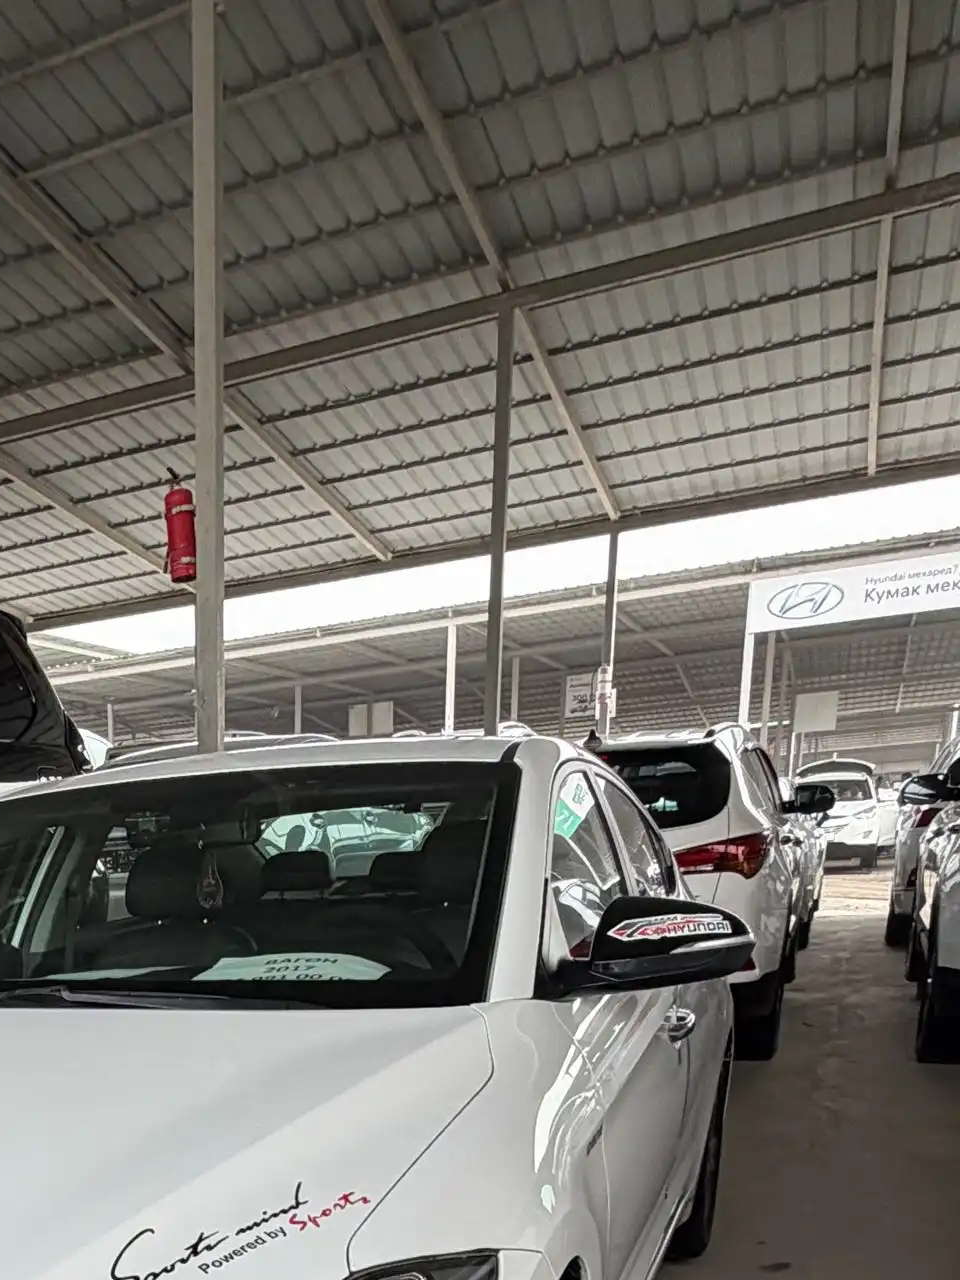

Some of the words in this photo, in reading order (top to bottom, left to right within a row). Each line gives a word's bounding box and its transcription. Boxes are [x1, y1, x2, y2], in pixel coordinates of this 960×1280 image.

[865, 571, 906, 586] Hyundai
[863, 584, 921, 605] Кумак
[666, 920, 730, 935] HYUNDAI
[197, 1232, 268, 1275] Powered
[266, 1225, 288, 1241] by
